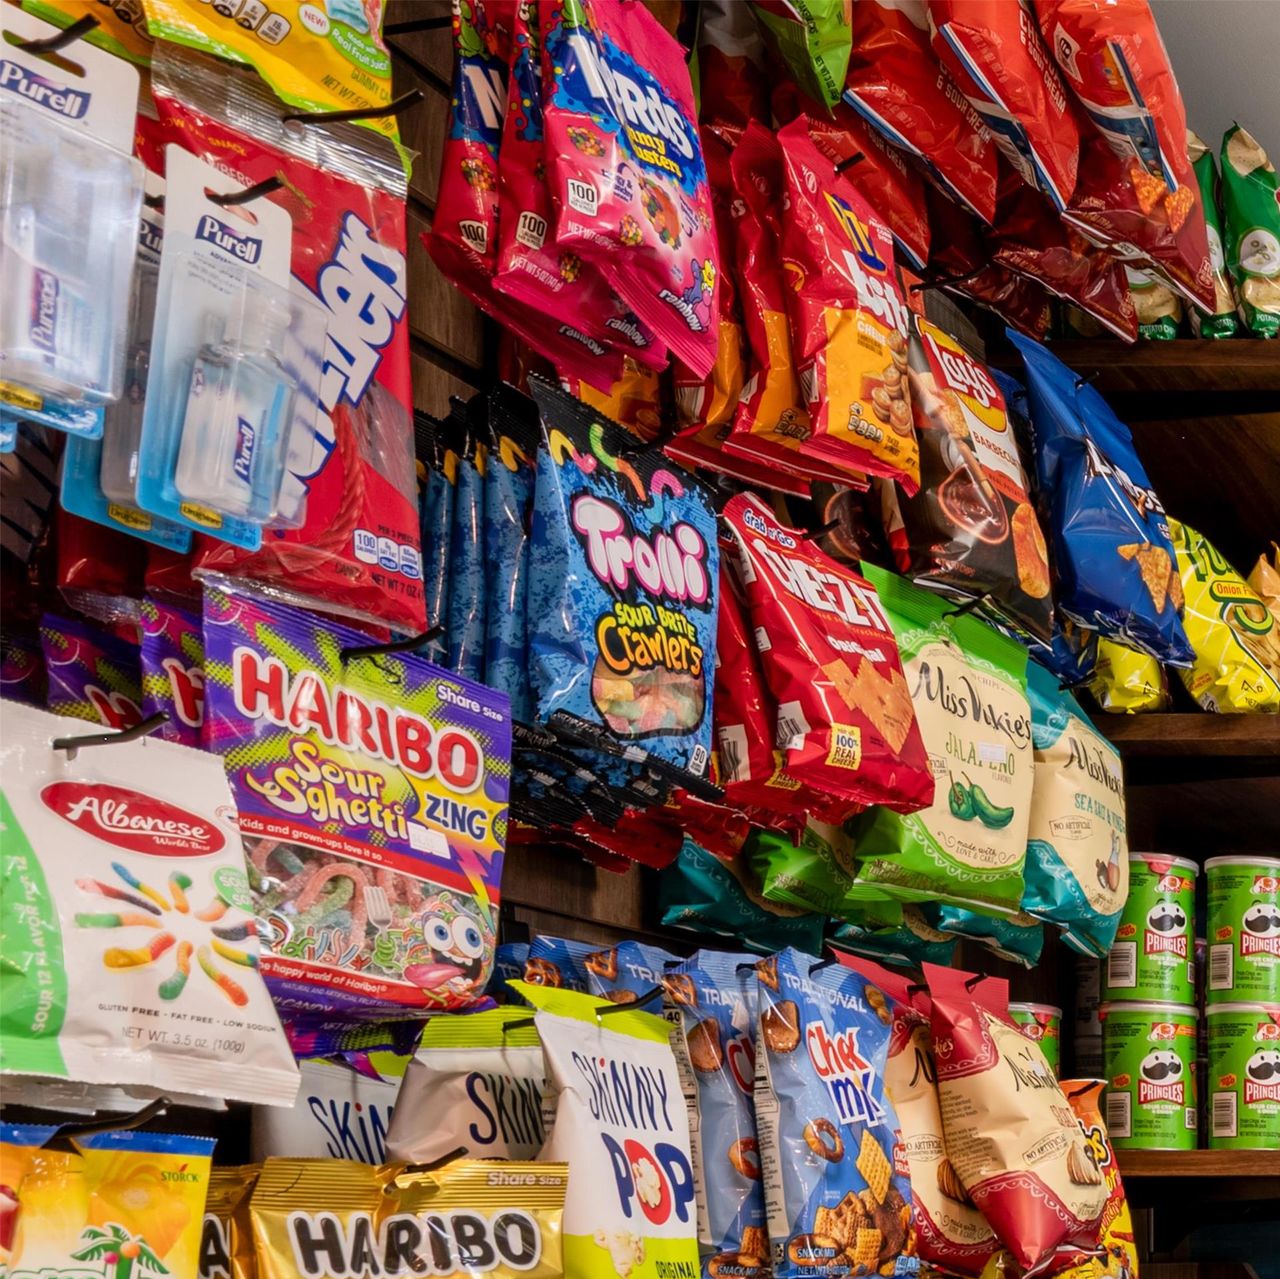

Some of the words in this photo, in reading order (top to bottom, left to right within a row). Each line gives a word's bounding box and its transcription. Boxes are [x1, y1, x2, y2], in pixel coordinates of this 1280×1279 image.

[304, 10, 326, 28] NEW!
[332, 28, 351, 50] Real
[351, 45, 371, 66] Fruit
[1, 63, 82, 117] Purell
[321, 74, 339, 90] NET
[339, 84, 355, 100] WT
[1043, 70, 1066, 120] CREAM
[944, 83, 967, 113] SOUR
[965, 108, 992, 145] CREAM
[569, 182, 595, 204] 100
[462, 225, 486, 243] 100
[521, 214, 546, 238] 100
[200, 217, 259, 263] Purell
[660, 289, 702, 333] rainbow
[606, 317, 647, 347] rainbow
[925, 332, 997, 409] Lay's
[236, 420, 254, 479] Purell
[743, 509, 767, 533] Grab
[357, 533, 375, 549] 100
[573, 498, 708, 603] Trolli
[372, 573, 386, 587] NET
[1216, 583, 1242, 596] Onion
[616, 604, 655, 630] SOUR
[598, 618, 703, 676] Crawlers
[437, 684, 481, 713] Share
[911, 661, 967, 719] Miss
[236, 649, 483, 793] HARIBO
[836, 733, 858, 749] 100%
[694, 747, 705, 762] 90
[831, 757, 856, 769] CHEESE
[835, 748, 857, 761] REAL
[1064, 737, 1102, 782] Miss
[292, 738, 386, 800] Sour
[1074, 793, 1093, 816] SEA
[66, 796, 211, 839] Albanese
[1054, 822, 1064, 831] NO
[240, 818, 264, 832] Kids
[266, 823, 289, 836] and
[292, 828, 338, 850] grown-ups
[340, 839, 360, 855] love
[361, 843, 369, 856] it
[370, 850, 381, 862] so
[957, 840, 977, 852] made
[978, 845, 997, 857] with
[1146, 933, 1187, 956] PRINGLES
[35, 969, 52, 988] 12
[276, 964, 308, 982] happy
[310, 969, 333, 984] world
[335, 973, 344, 986] of
[32, 987, 54, 1033] SOUR
[99, 1003, 129, 1013] GLUTEN
[132, 1007, 160, 1017] FREE
[171, 1012, 187, 1022] FAT
[191, 1014, 213, 1024] FREE
[223, 1019, 243, 1028] LOW
[246, 1022, 277, 1033] SODIUM
[122, 1027, 143, 1041] NET
[173, 1033, 191, 1046] 3.5
[213, 1036, 246, 1054] (100g)
[1139, 1082, 1183, 1104] PRINGLES
[1026, 1151, 1037, 1161] NO
[161, 1170, 199, 1184] STORCK
[488, 1171, 537, 1187] Share
[600, 1132, 696, 1226] POP
[798, 1247, 824, 1259] SNACK
[655, 1260, 696, 1279] ORIGINAL
[718, 1264, 744, 1276] SNACK
